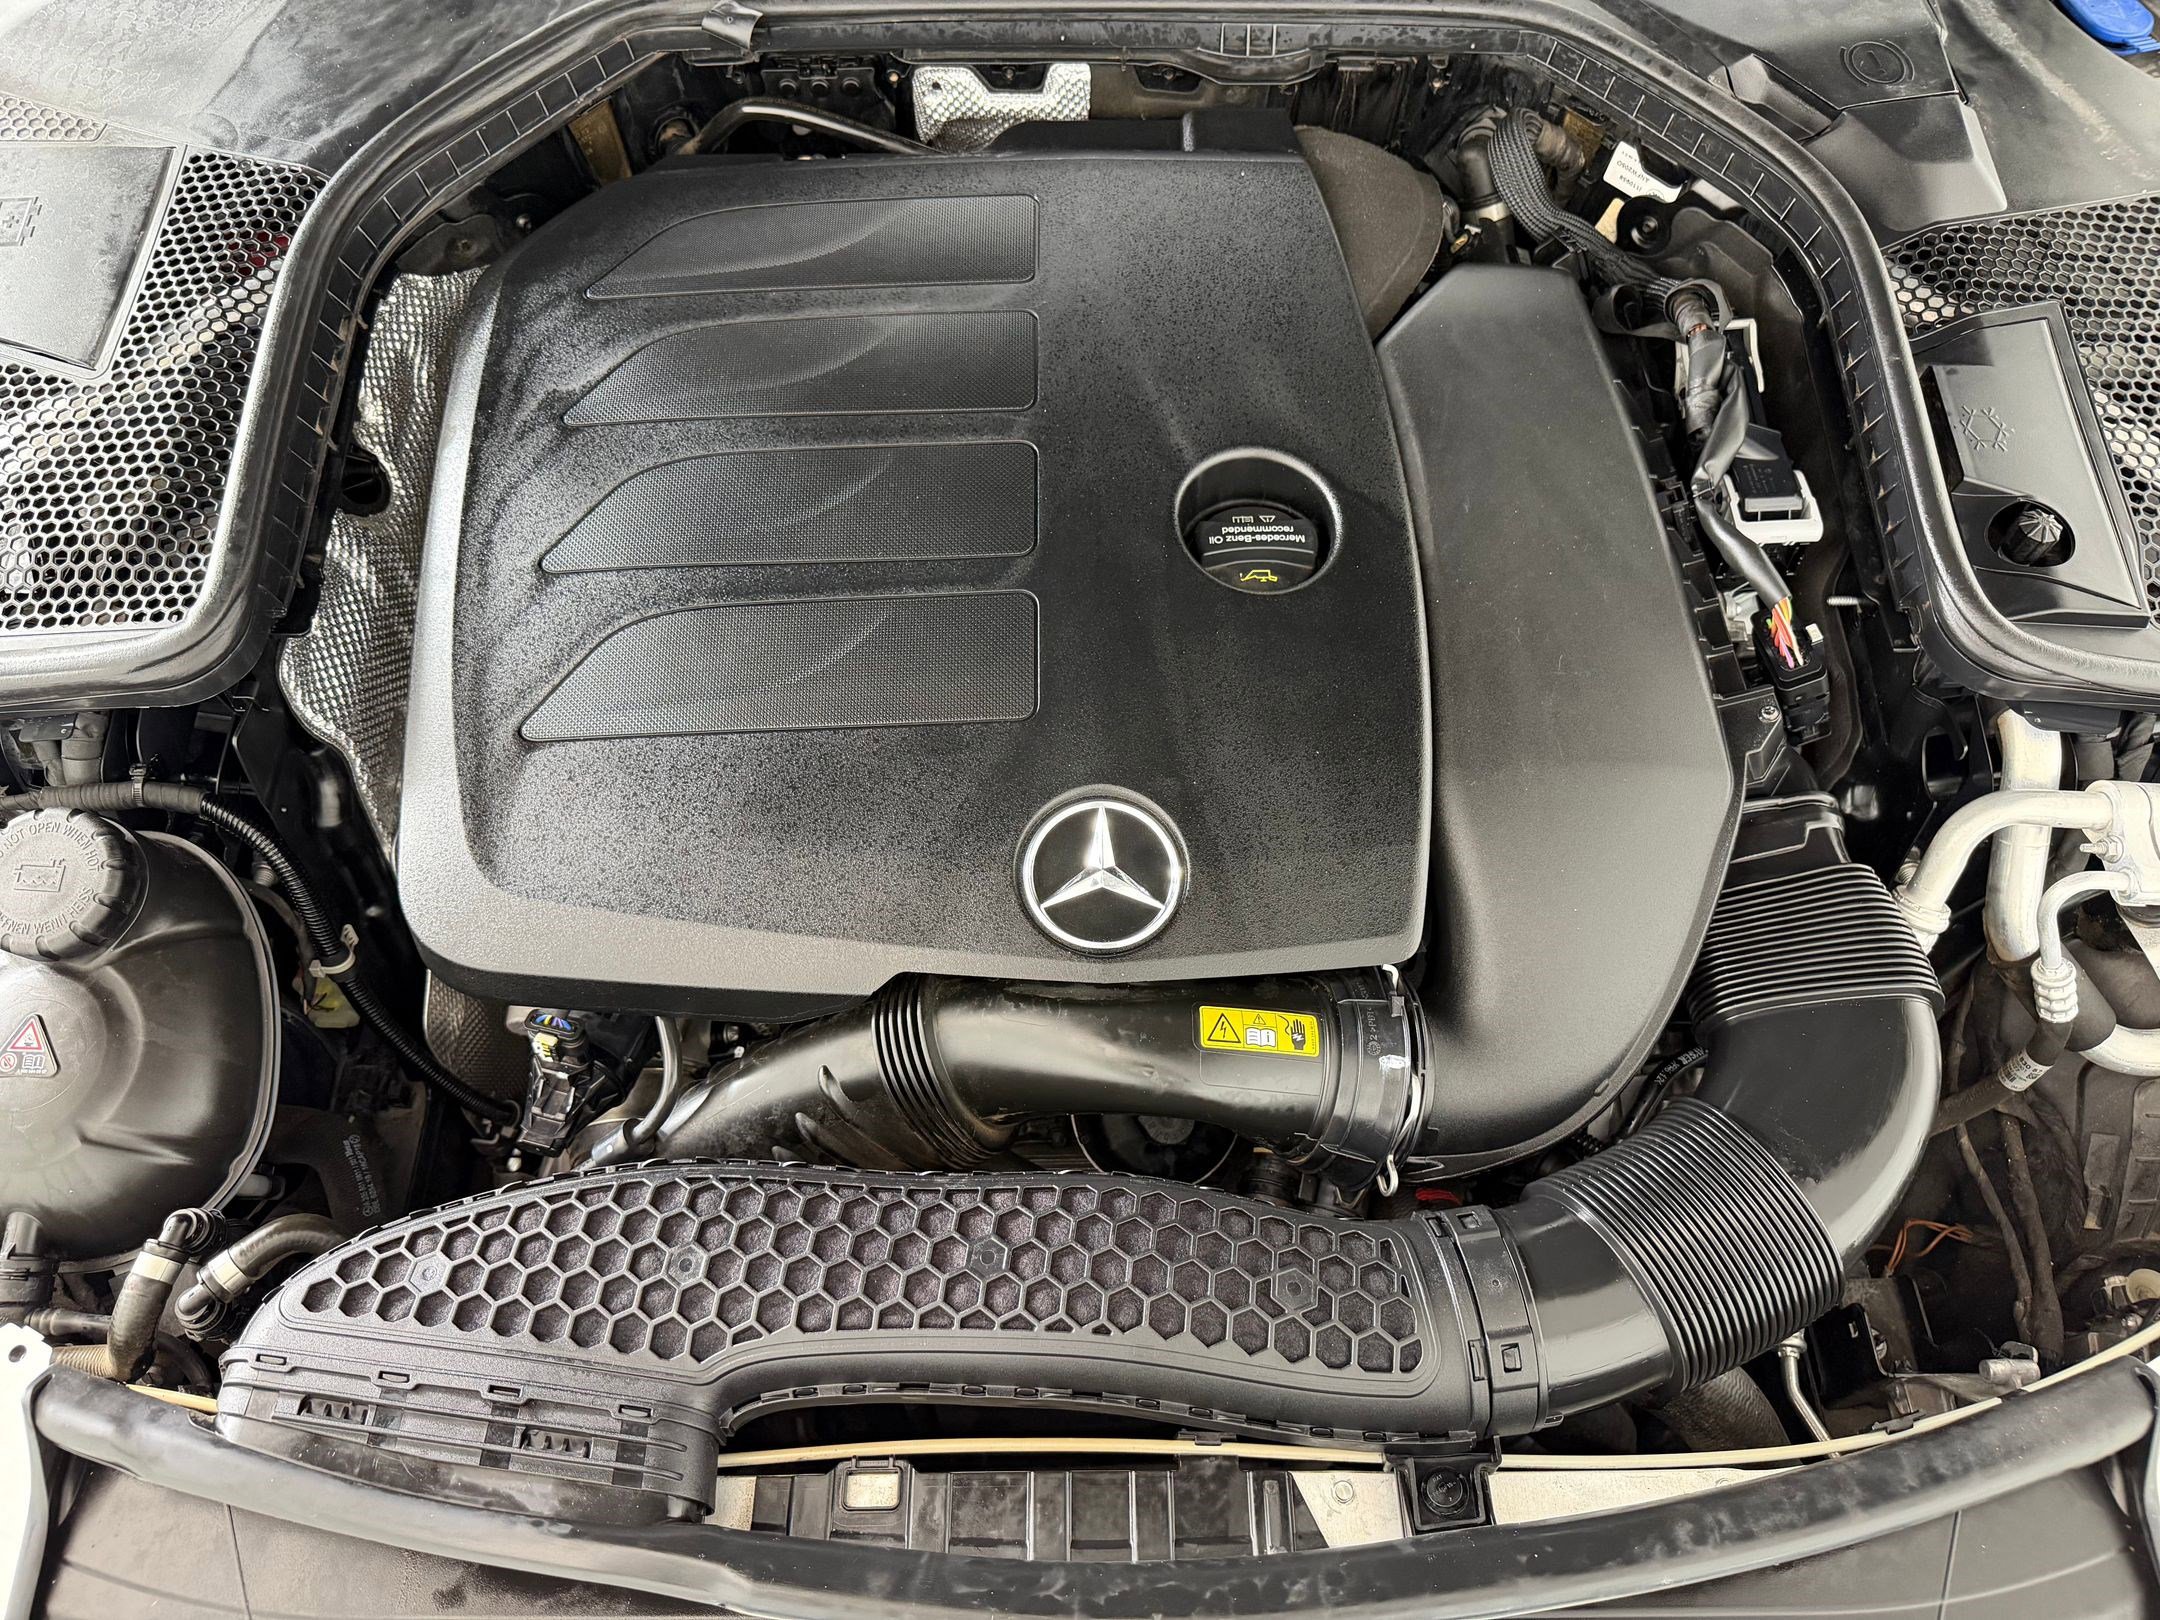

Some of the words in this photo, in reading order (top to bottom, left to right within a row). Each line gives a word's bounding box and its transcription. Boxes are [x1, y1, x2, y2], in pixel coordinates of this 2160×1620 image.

[1221, 525, 1294, 534] recommended
[1208, 536, 1224, 545] Oil
[1225, 534, 1306, 543] Mercedes-Benz
[3, 828, 25, 850] NOT
[28, 822, 61, 836] OPEN
[63, 824, 93, 854] WHEN
[85, 849, 101, 873] HOT
[0, 911, 31, 935] FFNEN
[33, 913, 68, 935] WENN
[66, 886, 95, 917] HEISS
